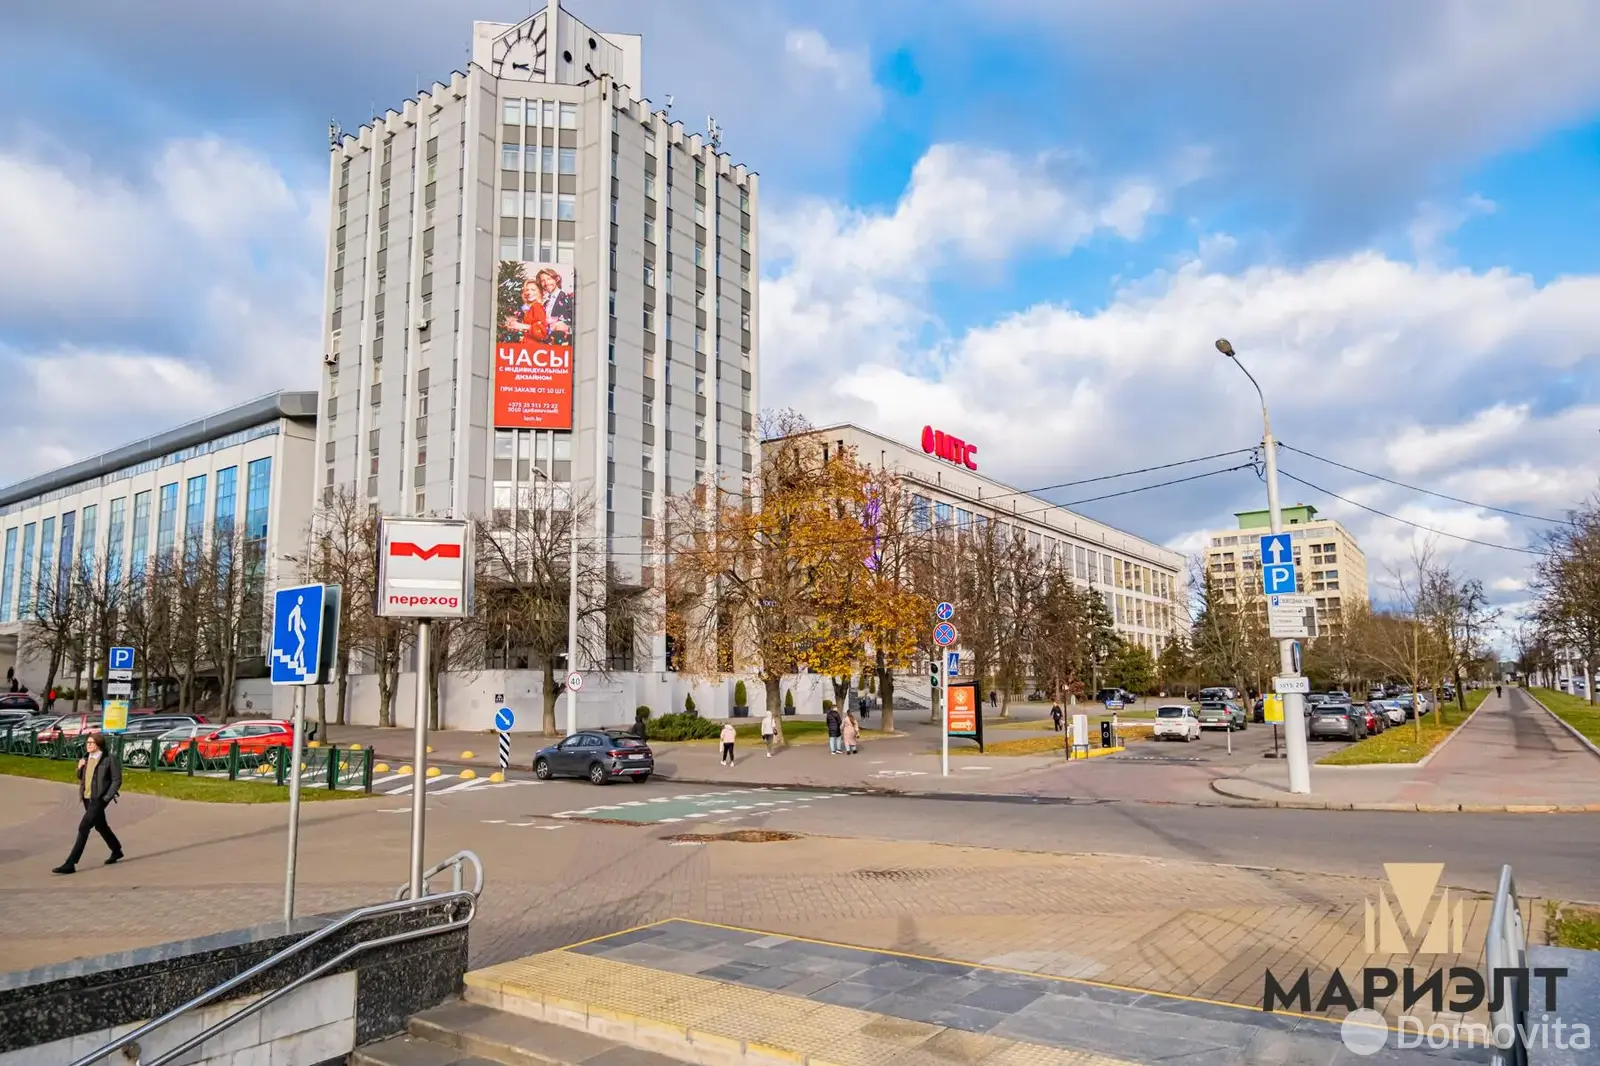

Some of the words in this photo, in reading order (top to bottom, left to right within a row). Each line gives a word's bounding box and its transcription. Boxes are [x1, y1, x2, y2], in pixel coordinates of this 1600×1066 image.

[499, 348, 569, 367] ЧАСЫ
[504, 366, 569, 374] ИНДИВИДУАЛЬНЫМ
[1271, 567, 1290, 591] P
[389, 595, 458, 607] переход
[115, 650, 129, 667] P
[571, 677, 580, 685] 40
